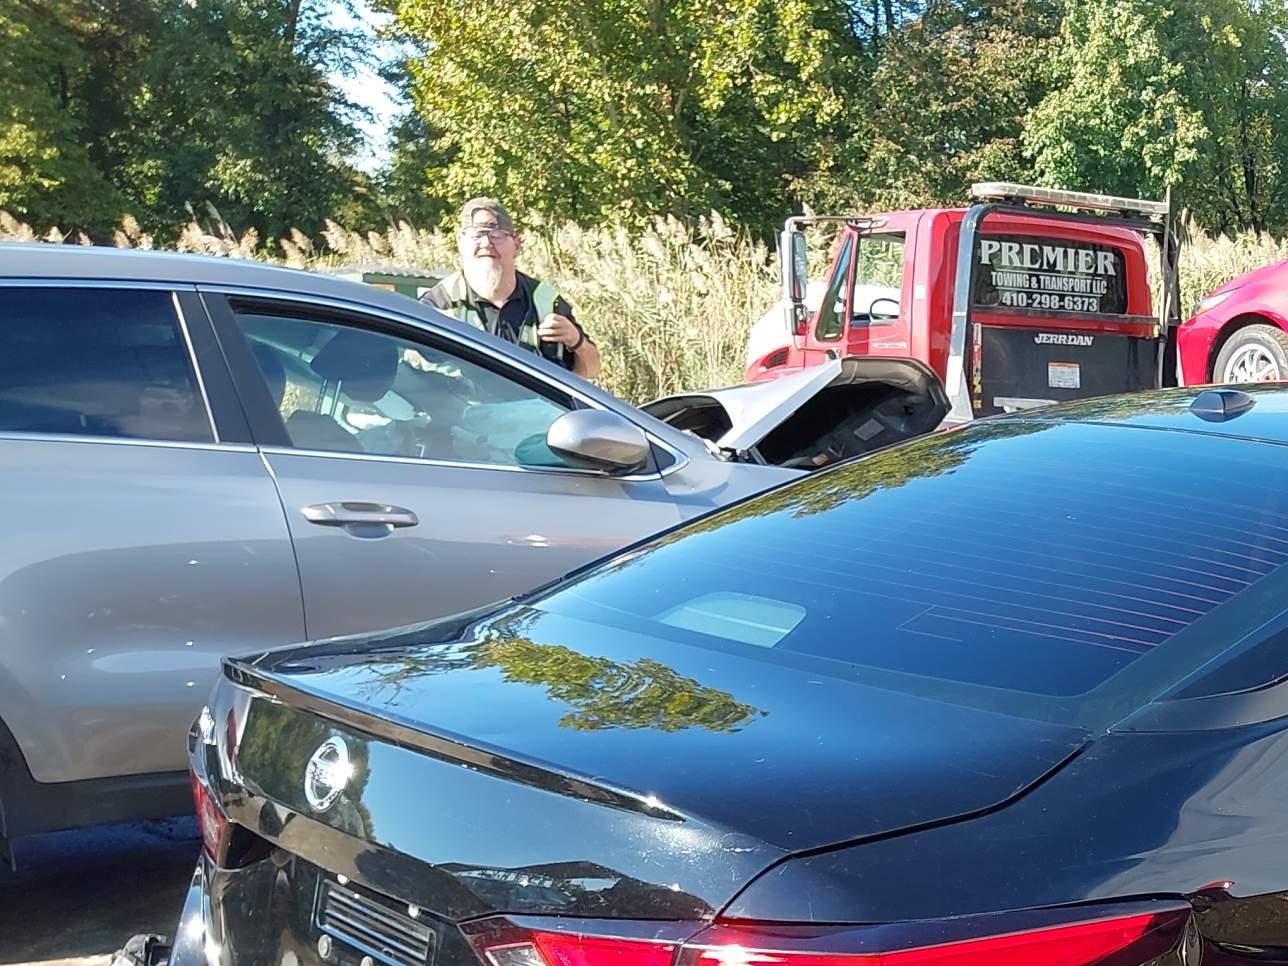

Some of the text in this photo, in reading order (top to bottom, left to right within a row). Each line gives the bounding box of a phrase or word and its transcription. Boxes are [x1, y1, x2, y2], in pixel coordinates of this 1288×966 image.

[980, 240, 1117, 276] PREMIER
[991, 271, 1107, 294] TOWING & TRANSPORT LLC
[1002, 292, 1098, 312] 410-298-6373
